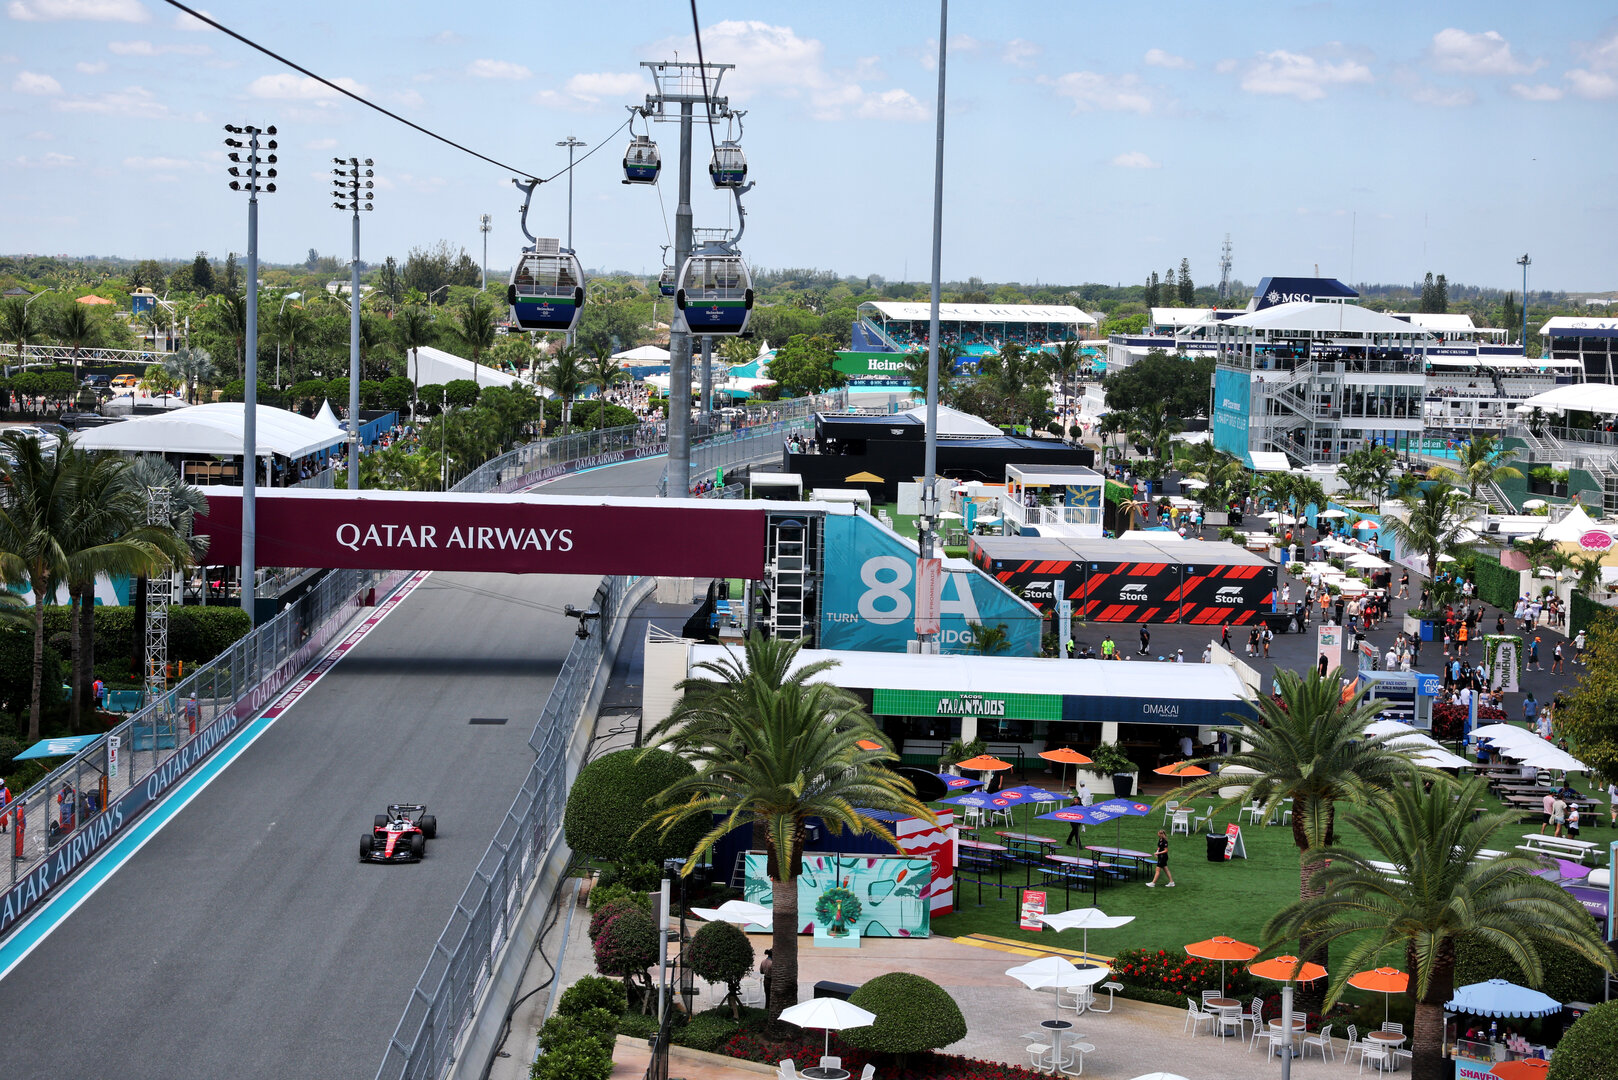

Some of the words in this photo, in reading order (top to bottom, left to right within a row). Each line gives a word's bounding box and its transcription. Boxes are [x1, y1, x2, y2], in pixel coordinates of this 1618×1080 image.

[1282, 293, 1310, 303] MSC
[635, 446, 657, 458] QATAR
[575, 457, 597, 471] QATAR
[597, 451, 625, 468] AIRWAYS
[335, 523, 438, 551] QATAR
[446, 526, 574, 551] AIRWAYS
[1024, 589, 1052, 599] Store
[1119, 592, 1148, 601] Store
[1215, 594, 1244, 604] Store
[826, 612, 859, 623] TURN
[931, 629, 981, 644] RIDGE
[1501, 646, 1511, 688] PROMENADE
[252, 670, 282, 711] QATAR
[282, 648, 311, 685] AIRWAYS
[1424, 679, 1439, 687] AM
[1425, 684, 1439, 693] EX
[937, 699, 1005, 715] ATARANTADOS
[1143, 703, 1179, 714] OMAKAI
[147, 748, 190, 801] QATAR
[191, 707, 237, 764] AIRWAYS
[0, 862, 50, 930] ATAR
[54, 801, 123, 883] AIRWAYS
